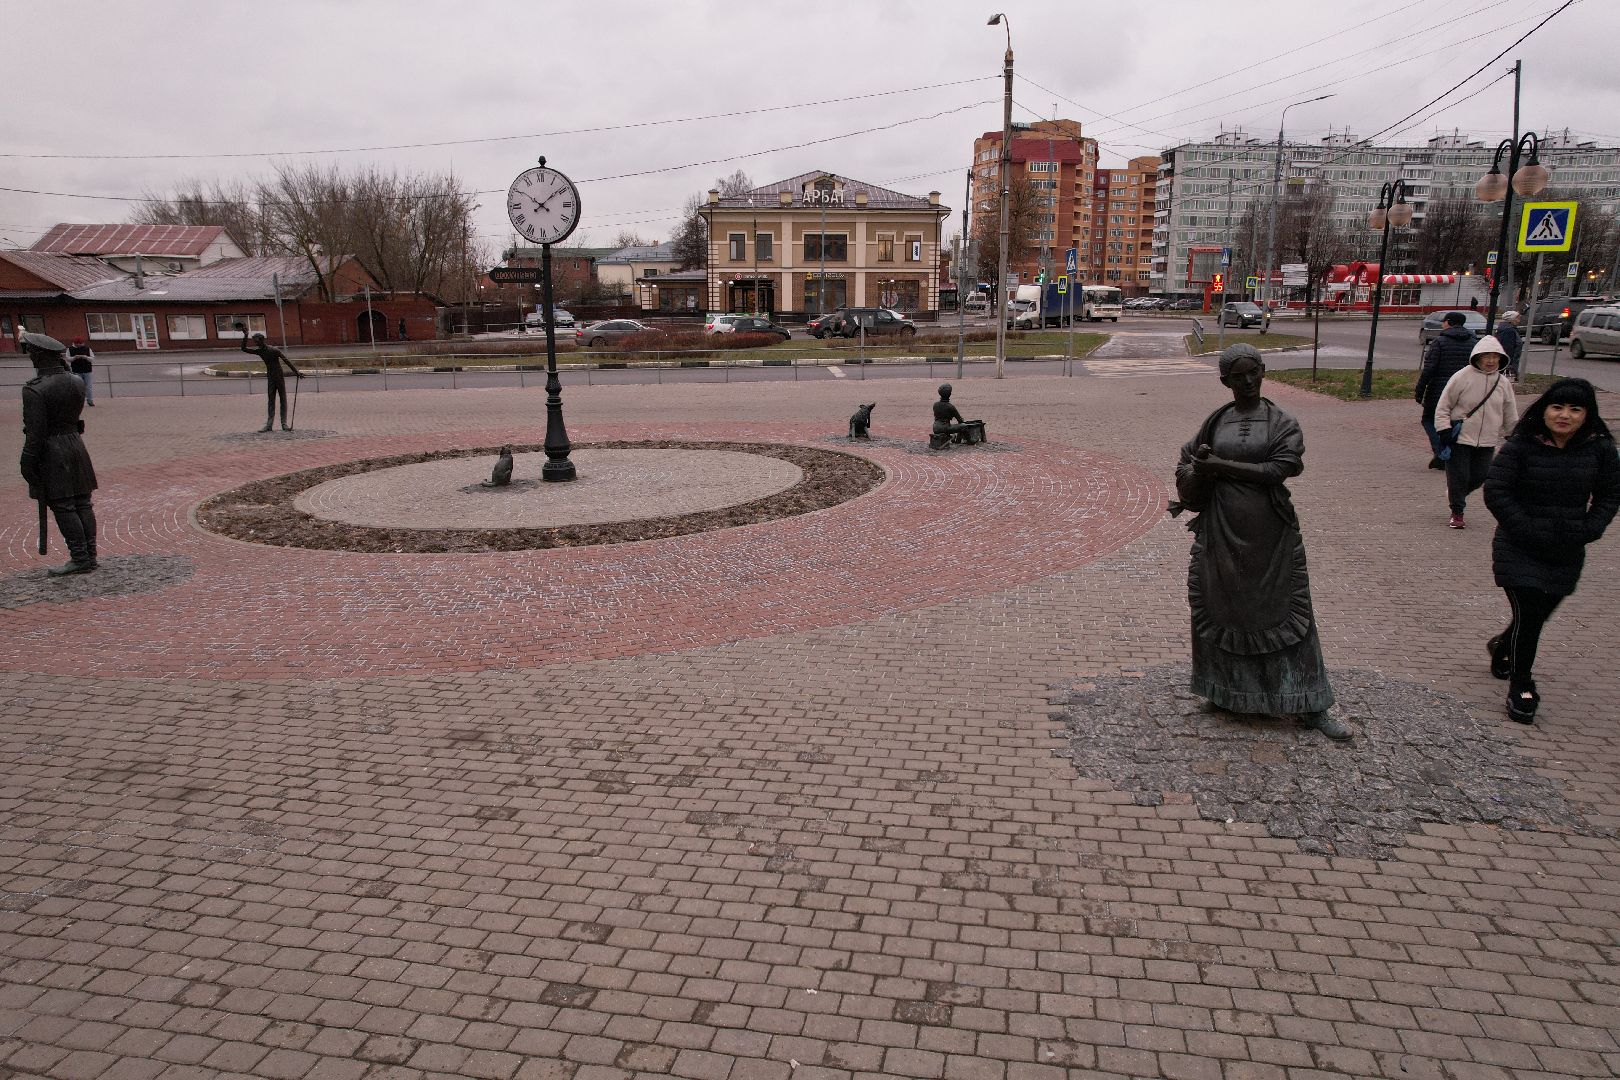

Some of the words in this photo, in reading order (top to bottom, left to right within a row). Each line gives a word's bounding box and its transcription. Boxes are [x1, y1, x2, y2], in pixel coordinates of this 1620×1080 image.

[536, 173, 544, 183] XII
[802, 189, 845, 203] АРБАТ
[1213, 282, 1223, 291] 55
